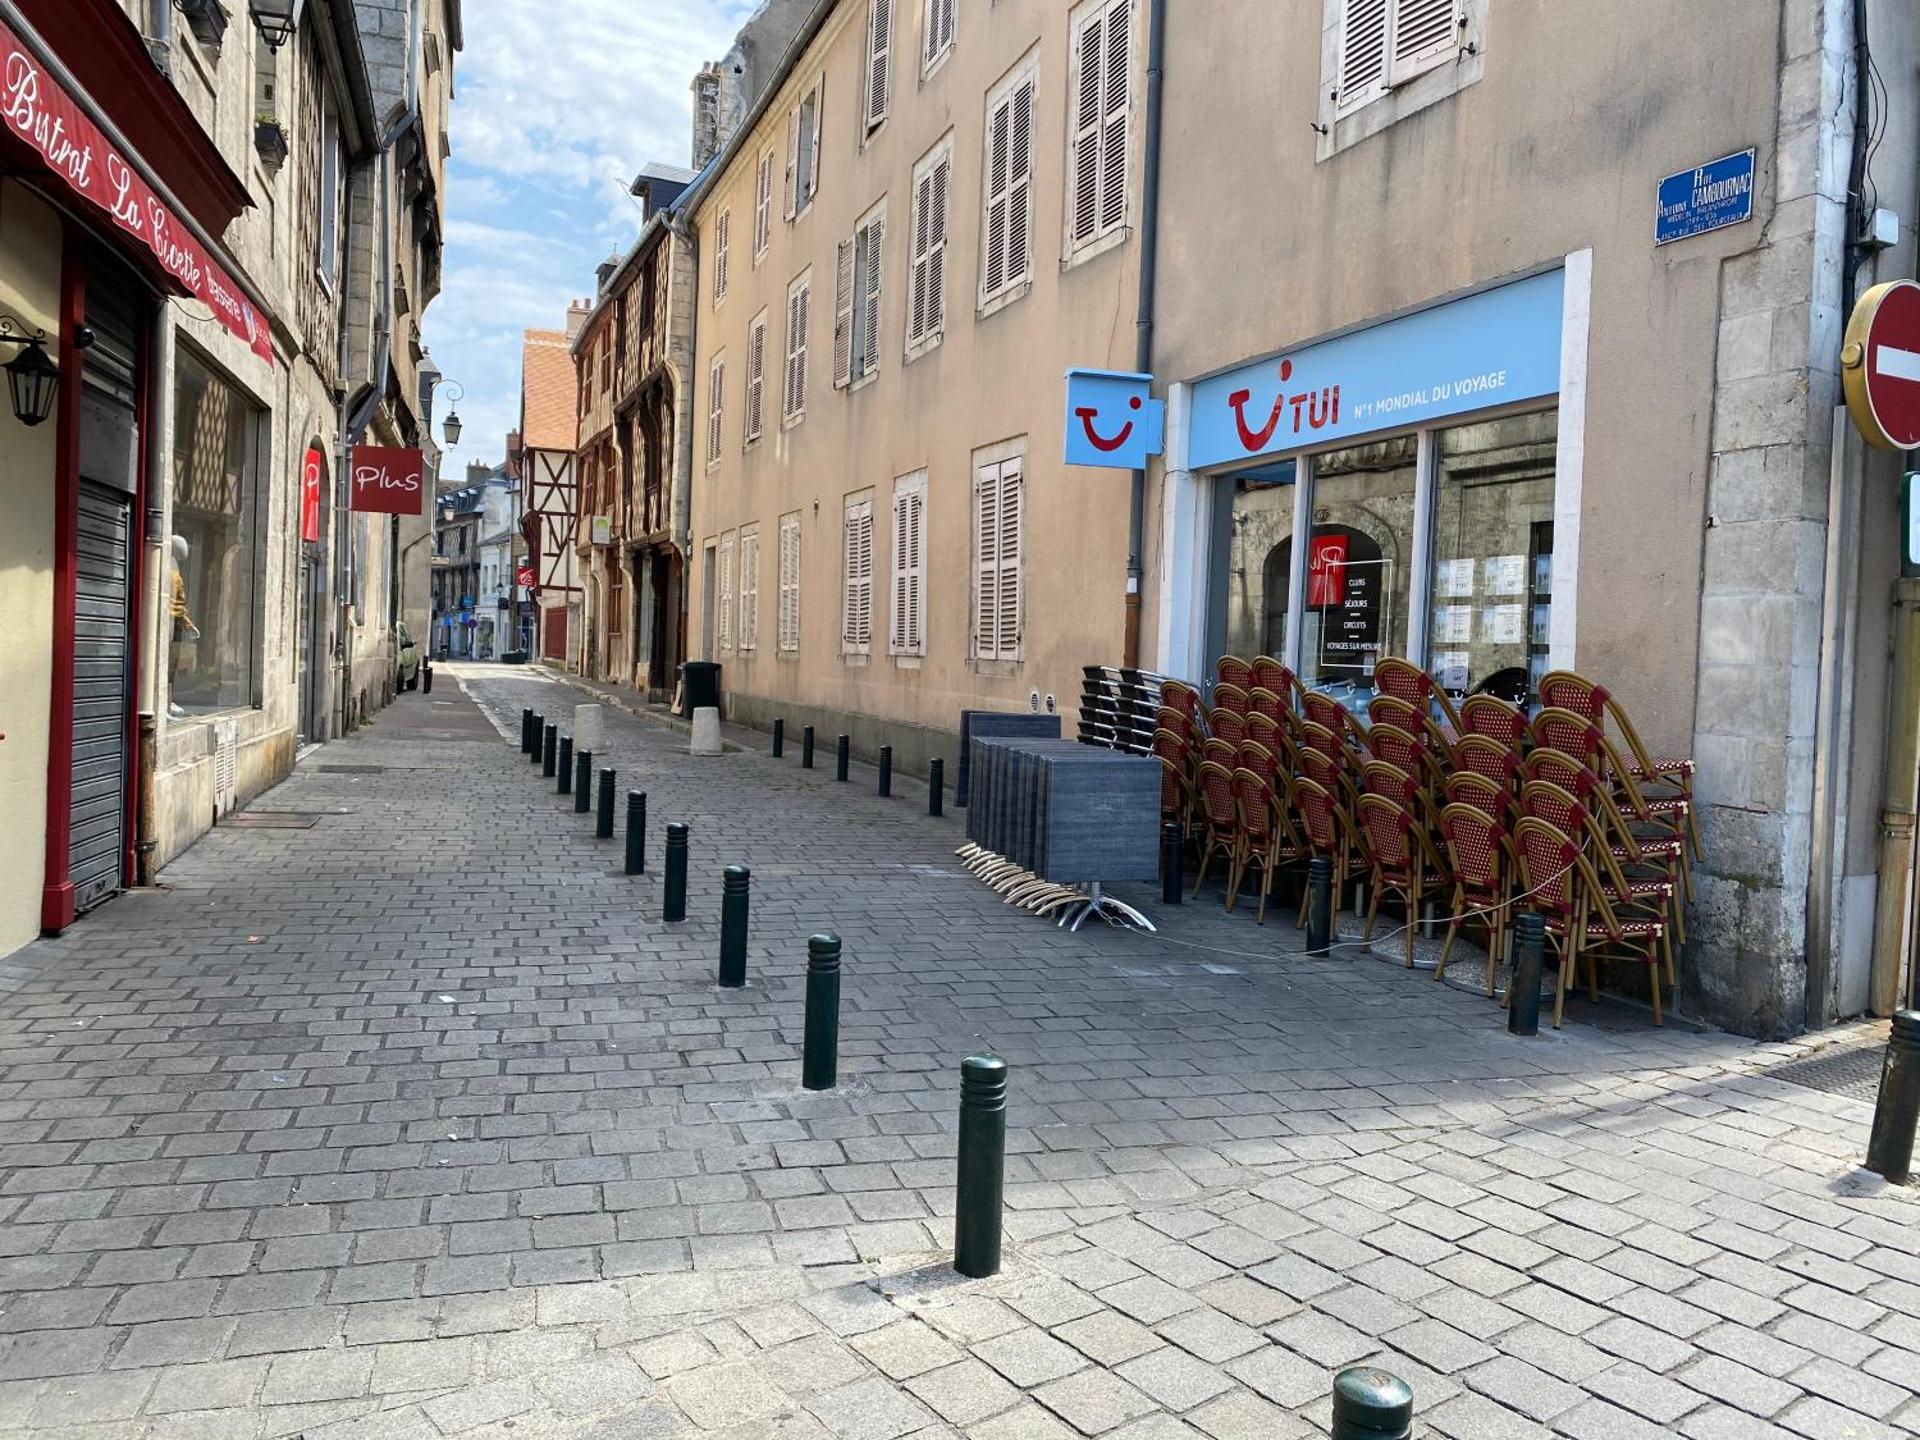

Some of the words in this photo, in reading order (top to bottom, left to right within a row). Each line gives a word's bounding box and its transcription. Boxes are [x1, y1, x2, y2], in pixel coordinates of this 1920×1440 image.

[108, 153, 143, 231] La
[1375, 391, 1429, 415] MONDIAL
[1432, 384, 1451, 402] DU
[1454, 370, 1507, 397] VOYAGE
[1289, 384, 1340, 433] TUI
[355, 466, 419, 492] Plus
[1348, 578, 1366, 587] CLUBS
[1344, 599, 1368, 608] SÉJOURS
[1343, 621, 1367, 630] CIRCUITS
[1327, 641, 1349, 650] VOYAGES
[1349, 641, 1360, 650] SUR
[1360, 642, 1382, 651] MESURE
